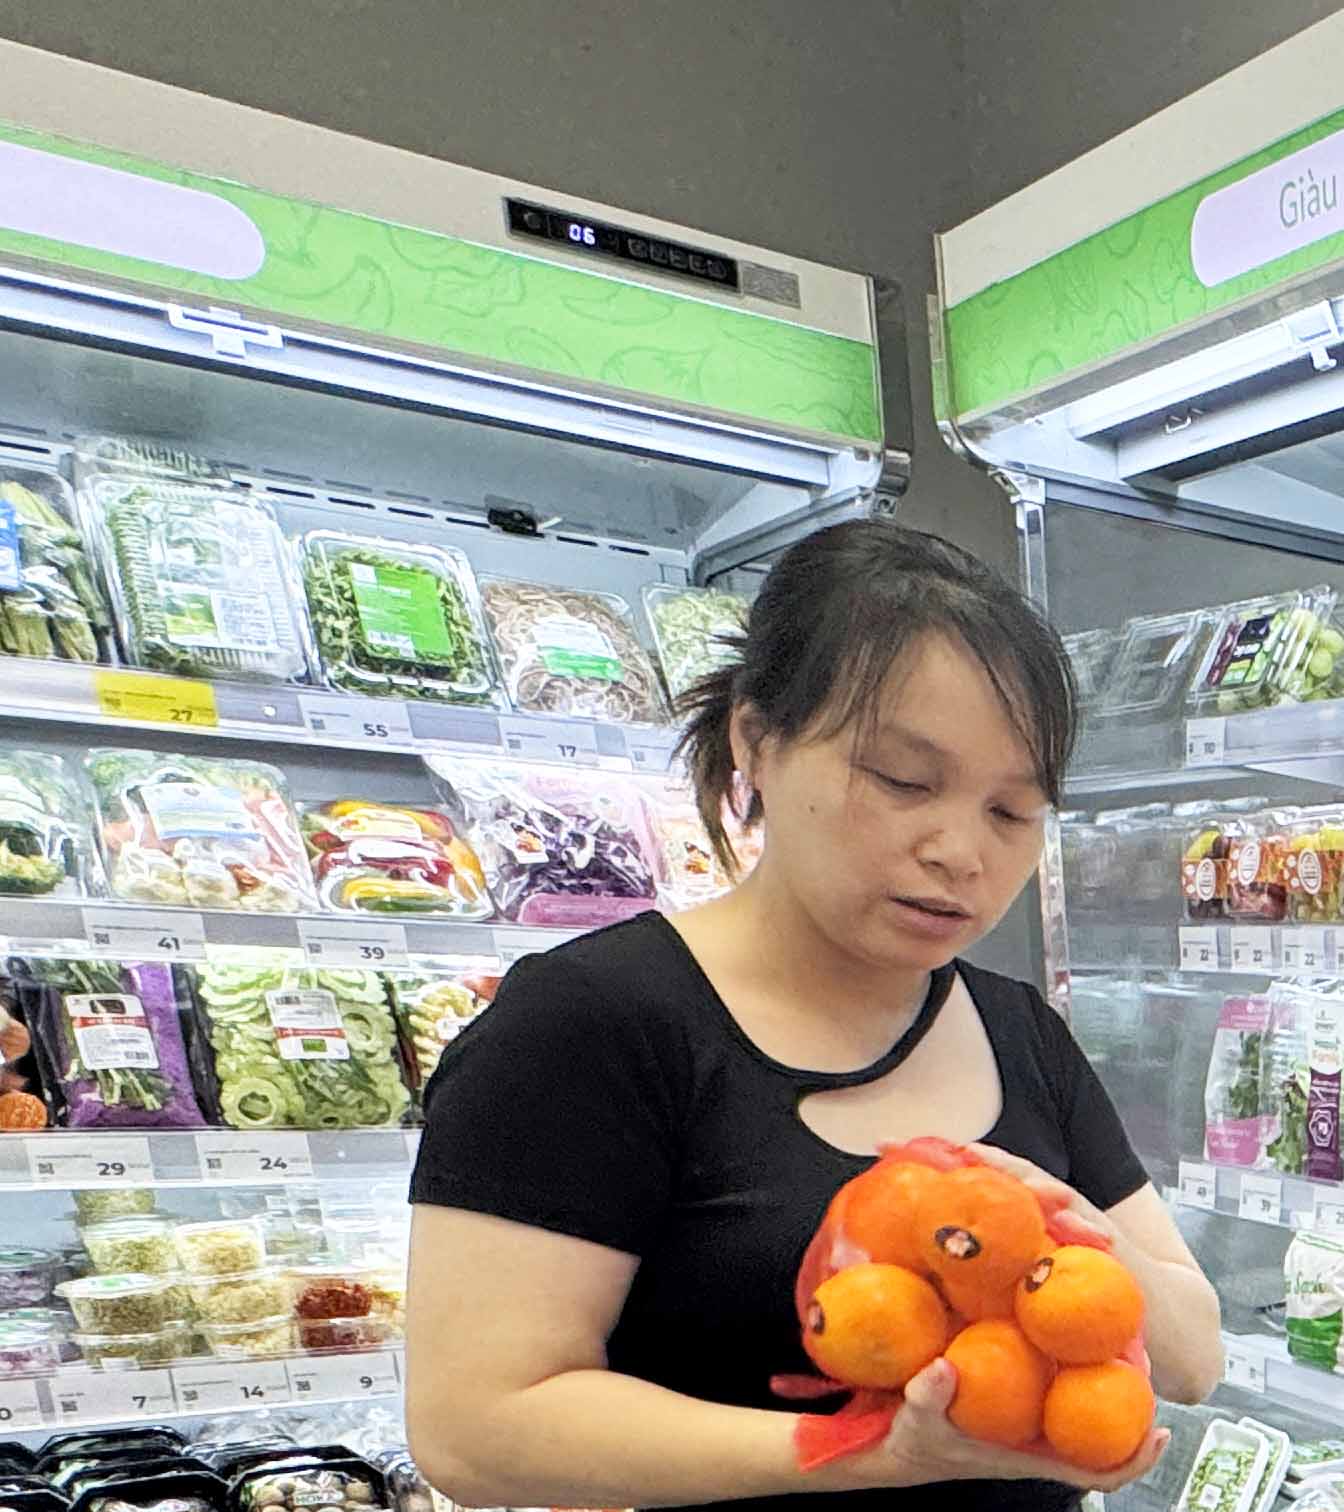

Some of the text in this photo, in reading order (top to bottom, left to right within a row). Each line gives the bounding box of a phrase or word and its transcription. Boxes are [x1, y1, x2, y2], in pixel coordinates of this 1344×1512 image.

[1279, 168, 1338, 230] Giàu
[168, 707, 193, 723] 27
[363, 723, 388, 739] 55
[557, 744, 578, 758] 17
[157, 935, 181, 953] 41
[359, 944, 386, 961] 39
[96, 1160, 126, 1178] 29
[260, 1156, 288, 1172] 24
[360, 1374, 373, 1390] 9
[240, 1384, 264, 1399] 14
[133, 1395, 147, 1410] 7
